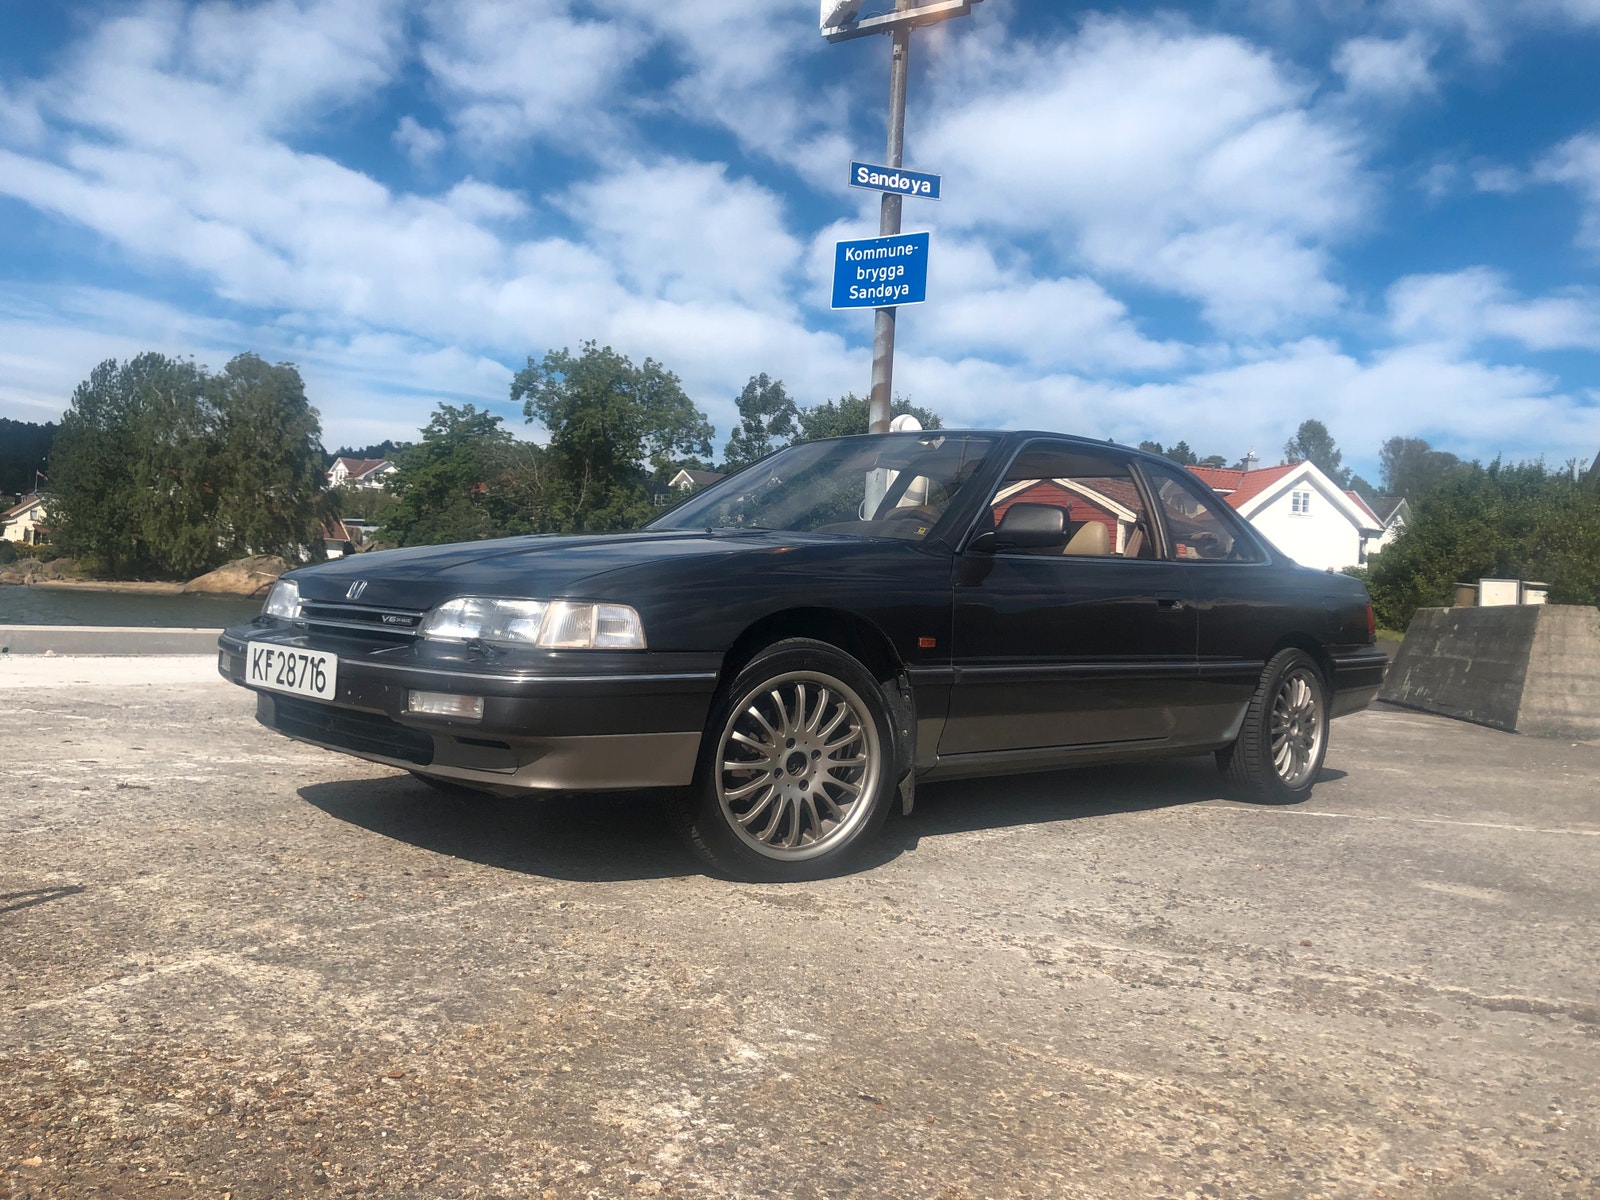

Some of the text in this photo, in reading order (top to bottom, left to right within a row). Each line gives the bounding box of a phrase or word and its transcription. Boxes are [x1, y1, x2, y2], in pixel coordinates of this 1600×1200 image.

[857, 167, 931, 193] Sandøya
[845, 244, 919, 261] Kommune-
[856, 265, 904, 282] brygga
[849, 283, 909, 299] Sandøya
